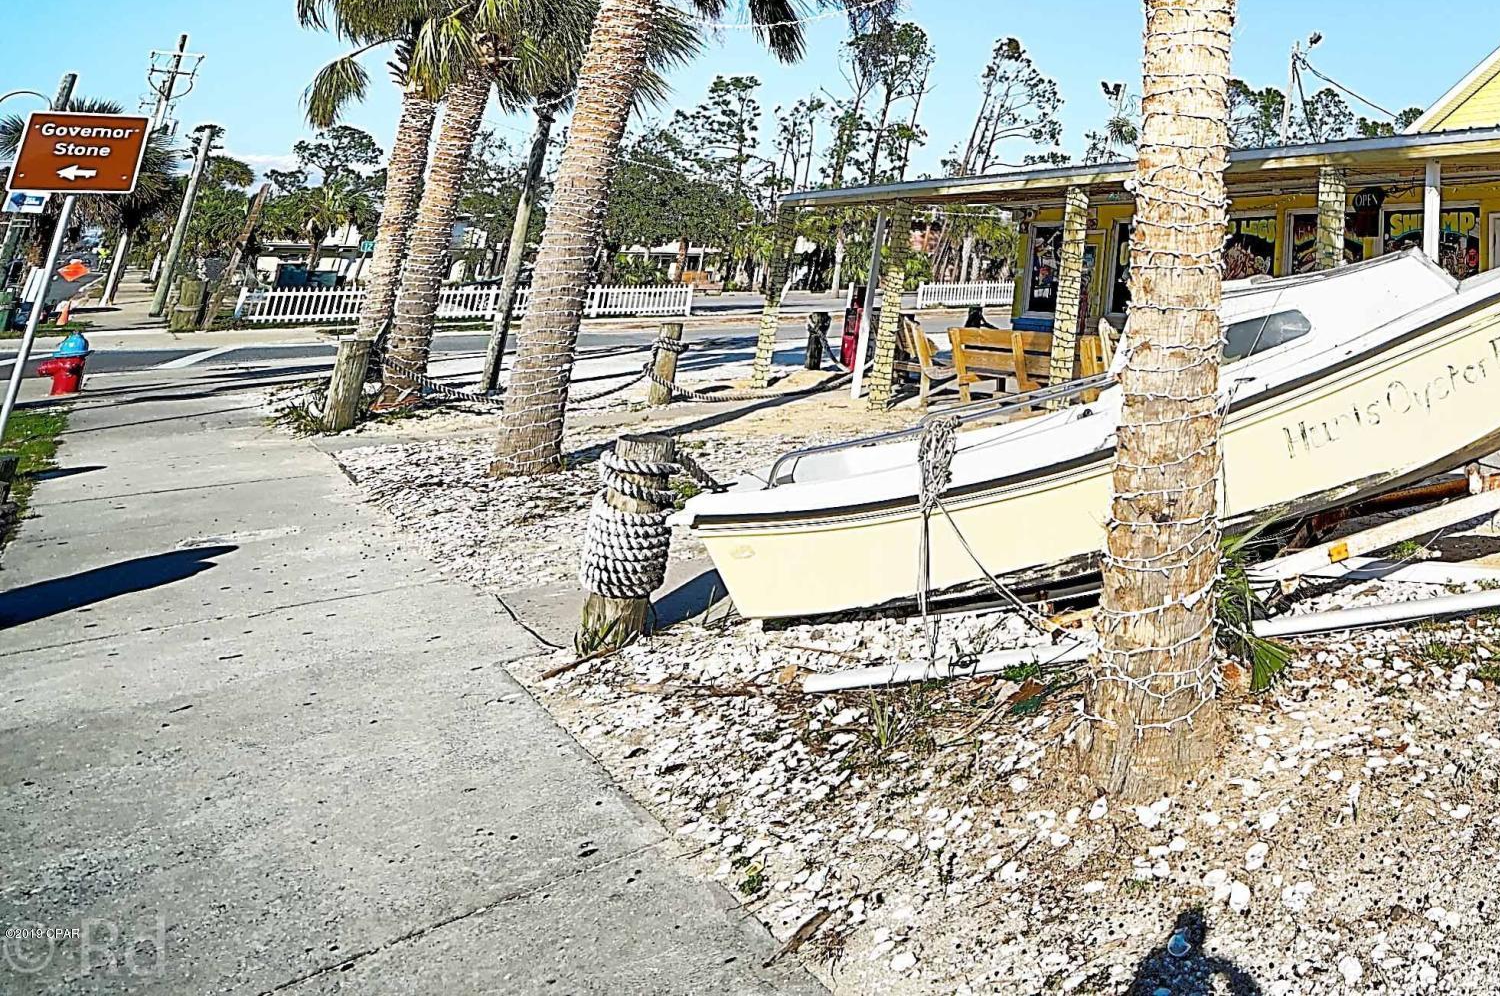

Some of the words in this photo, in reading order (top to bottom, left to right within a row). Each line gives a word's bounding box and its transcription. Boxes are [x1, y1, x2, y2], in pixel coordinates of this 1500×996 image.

[41, 123, 133, 139] Governor
[53, 142, 111, 157] Stone
[1240, 219, 1276, 243] LEGS
[1390, 211, 1475, 237] SHMP
[1386, 358, 1487, 414] Oyster
